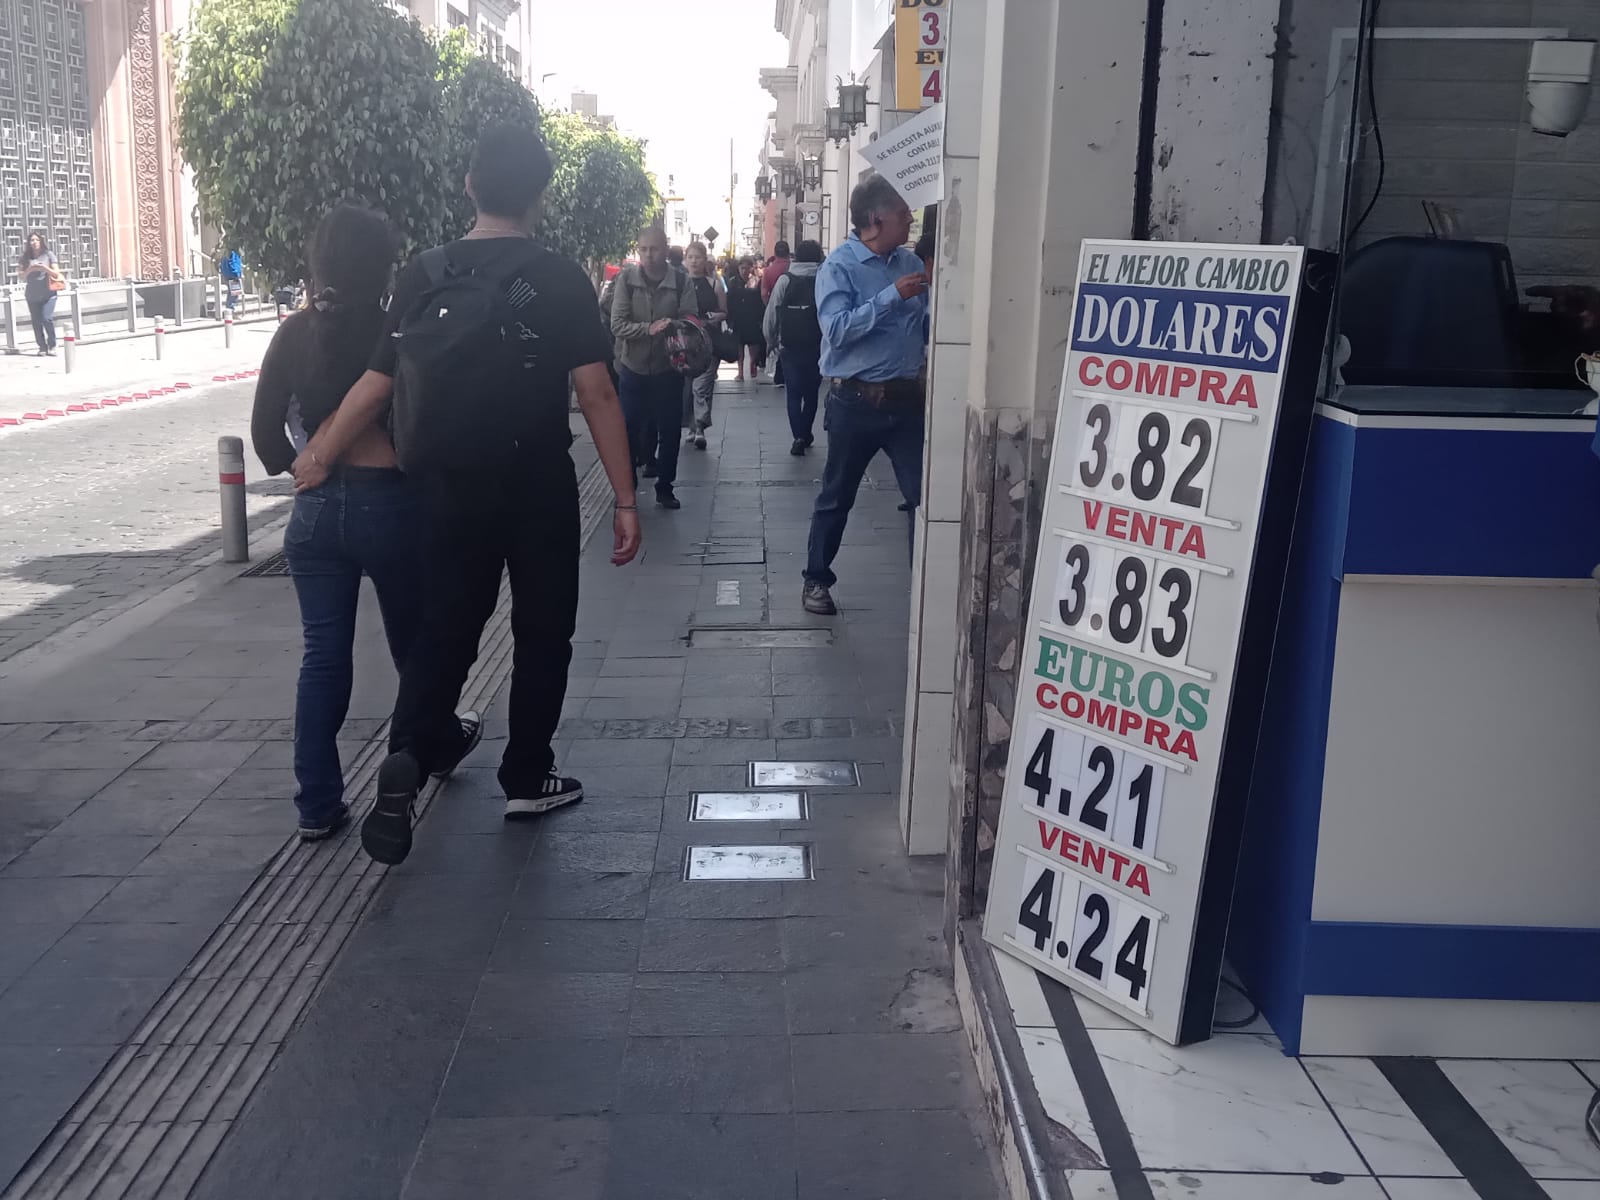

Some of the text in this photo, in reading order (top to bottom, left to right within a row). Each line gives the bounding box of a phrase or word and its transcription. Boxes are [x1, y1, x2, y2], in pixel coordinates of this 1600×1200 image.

[886, 131, 924, 155] NECESITA
[1087, 253, 1290, 293] EL MEJOR CAMBIO
[1077, 294, 1281, 363] DOLARES
[1078, 356, 1259, 409] COMPRA
[1079, 403, 1213, 508] 3.82
[1083, 500, 1207, 560] VENTA
[1059, 543, 1192, 658] 3.83
[1034, 635, 1210, 732] EUROS
[1036, 683, 1199, 762] COMPRA
[1024, 727, 1154, 850] 4.21
[1038, 820, 1151, 897] VENTA
[1018, 867, 1148, 1002] 4.24
